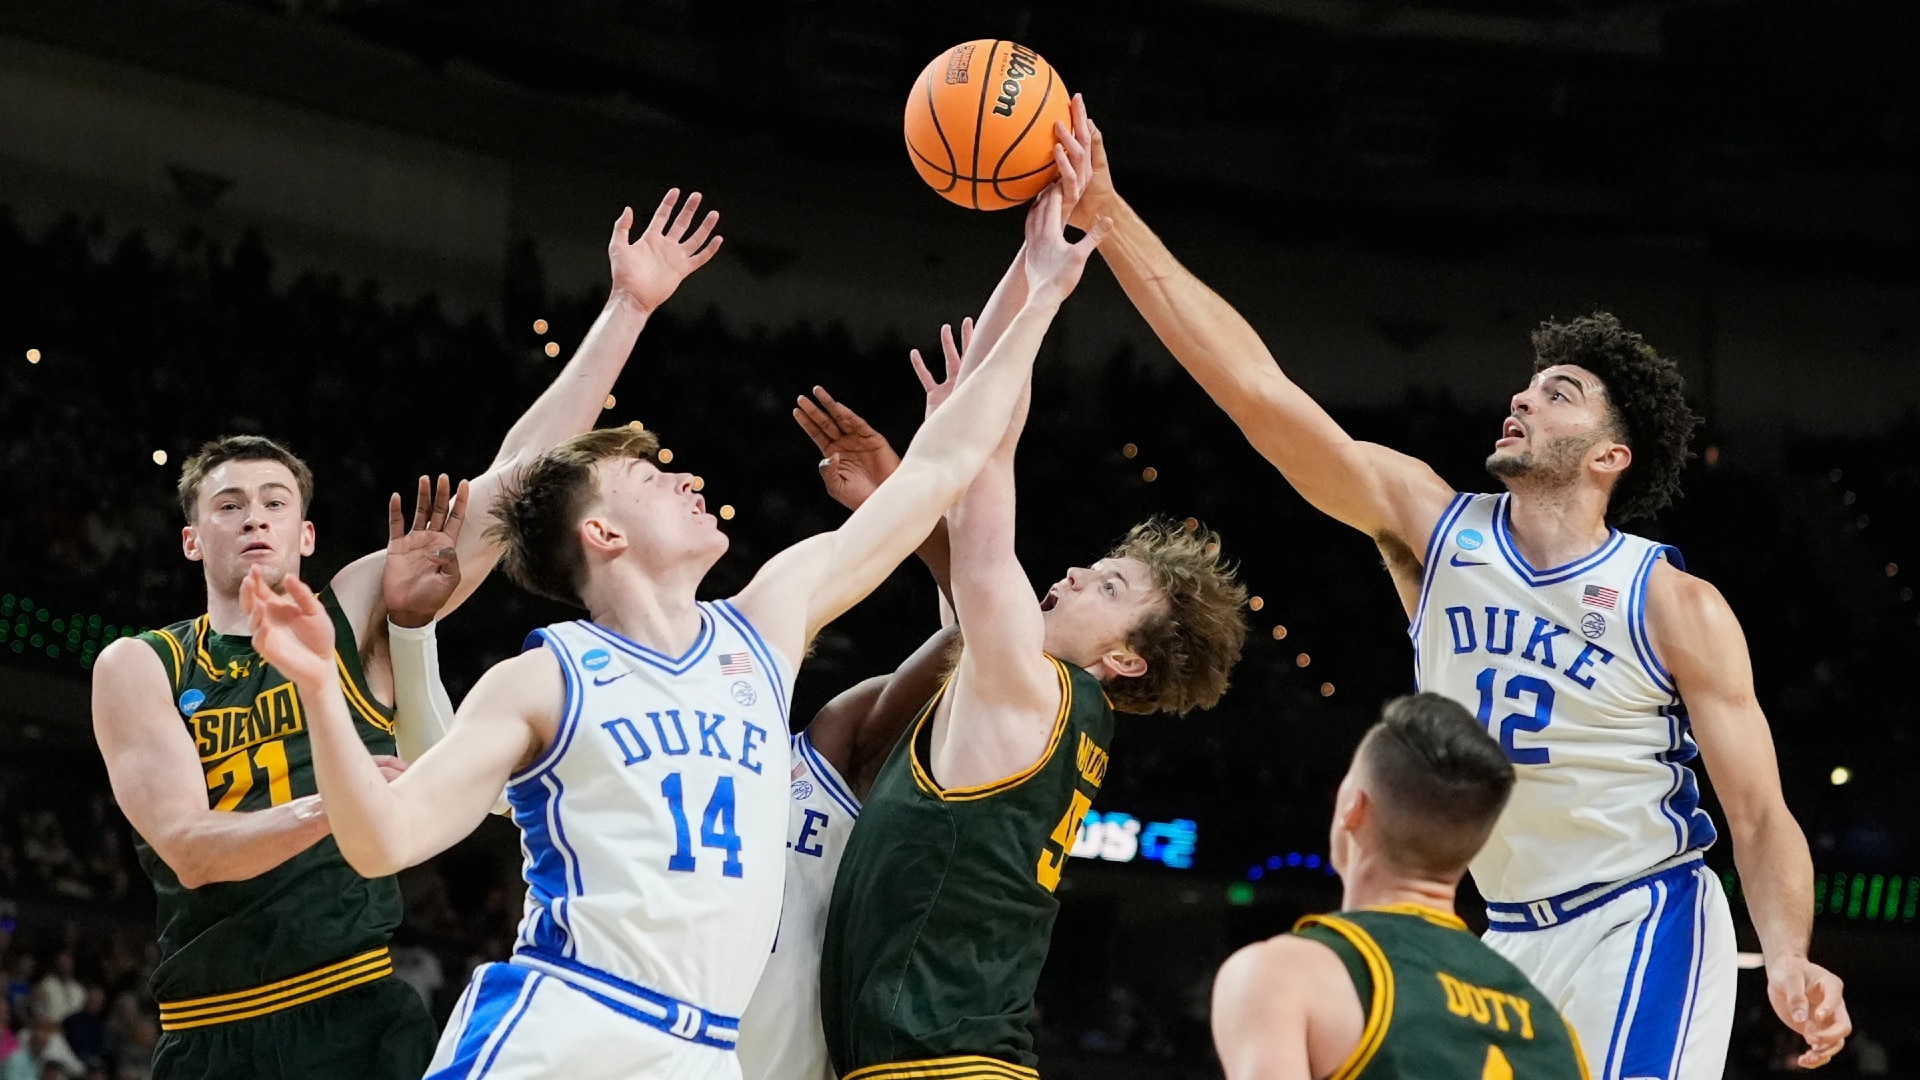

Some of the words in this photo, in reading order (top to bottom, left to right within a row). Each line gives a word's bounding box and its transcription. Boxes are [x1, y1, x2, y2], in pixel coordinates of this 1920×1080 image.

[992, 43, 1037, 117] Wilson
[1445, 606, 1615, 690] DUKE
[196, 686, 299, 759] SIENA
[601, 709, 768, 776] DUKE
[1475, 667, 1555, 765] 12
[206, 740, 292, 812] 21
[661, 772, 743, 879] 14
[1436, 972, 1534, 1040] DOTY
